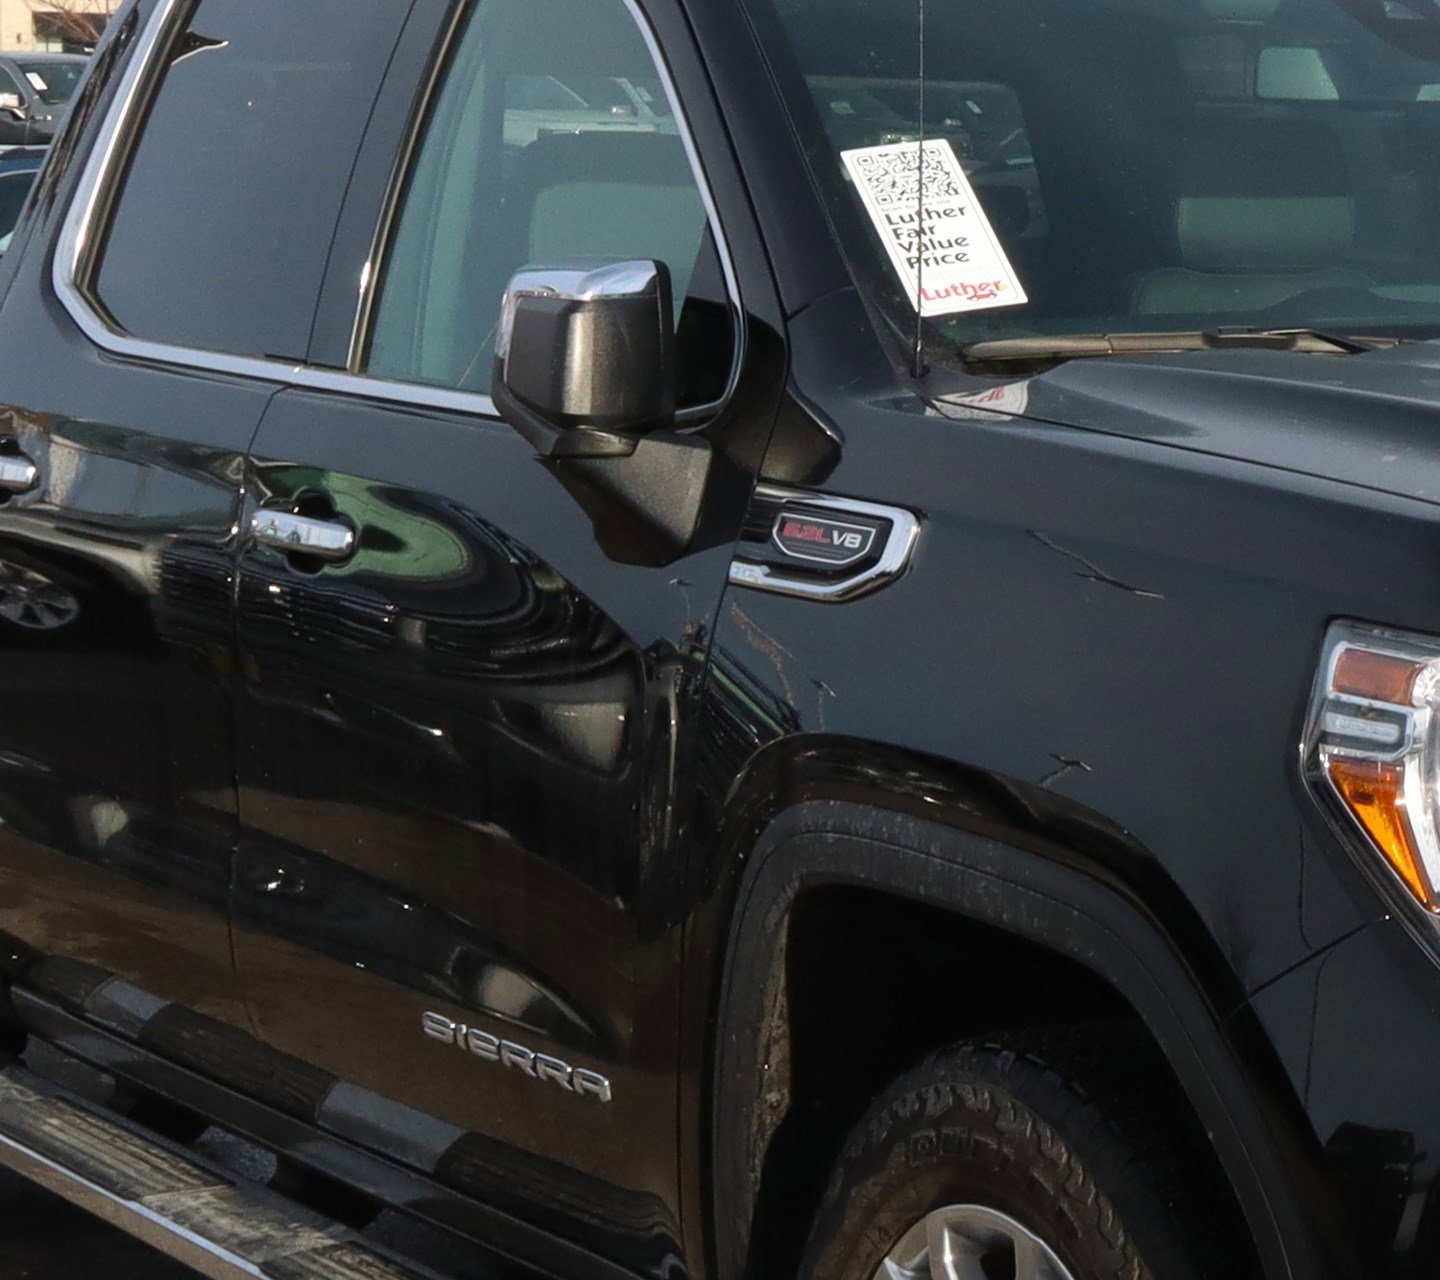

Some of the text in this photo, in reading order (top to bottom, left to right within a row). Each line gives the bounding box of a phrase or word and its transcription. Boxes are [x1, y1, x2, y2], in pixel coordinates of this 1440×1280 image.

[897, 236, 970, 254] Value
[905, 252, 970, 270] Price
[920, 280, 1002, 301] Luther
[832, 530, 863, 548] V8
[421, 1010, 612, 1103] SIERRA
